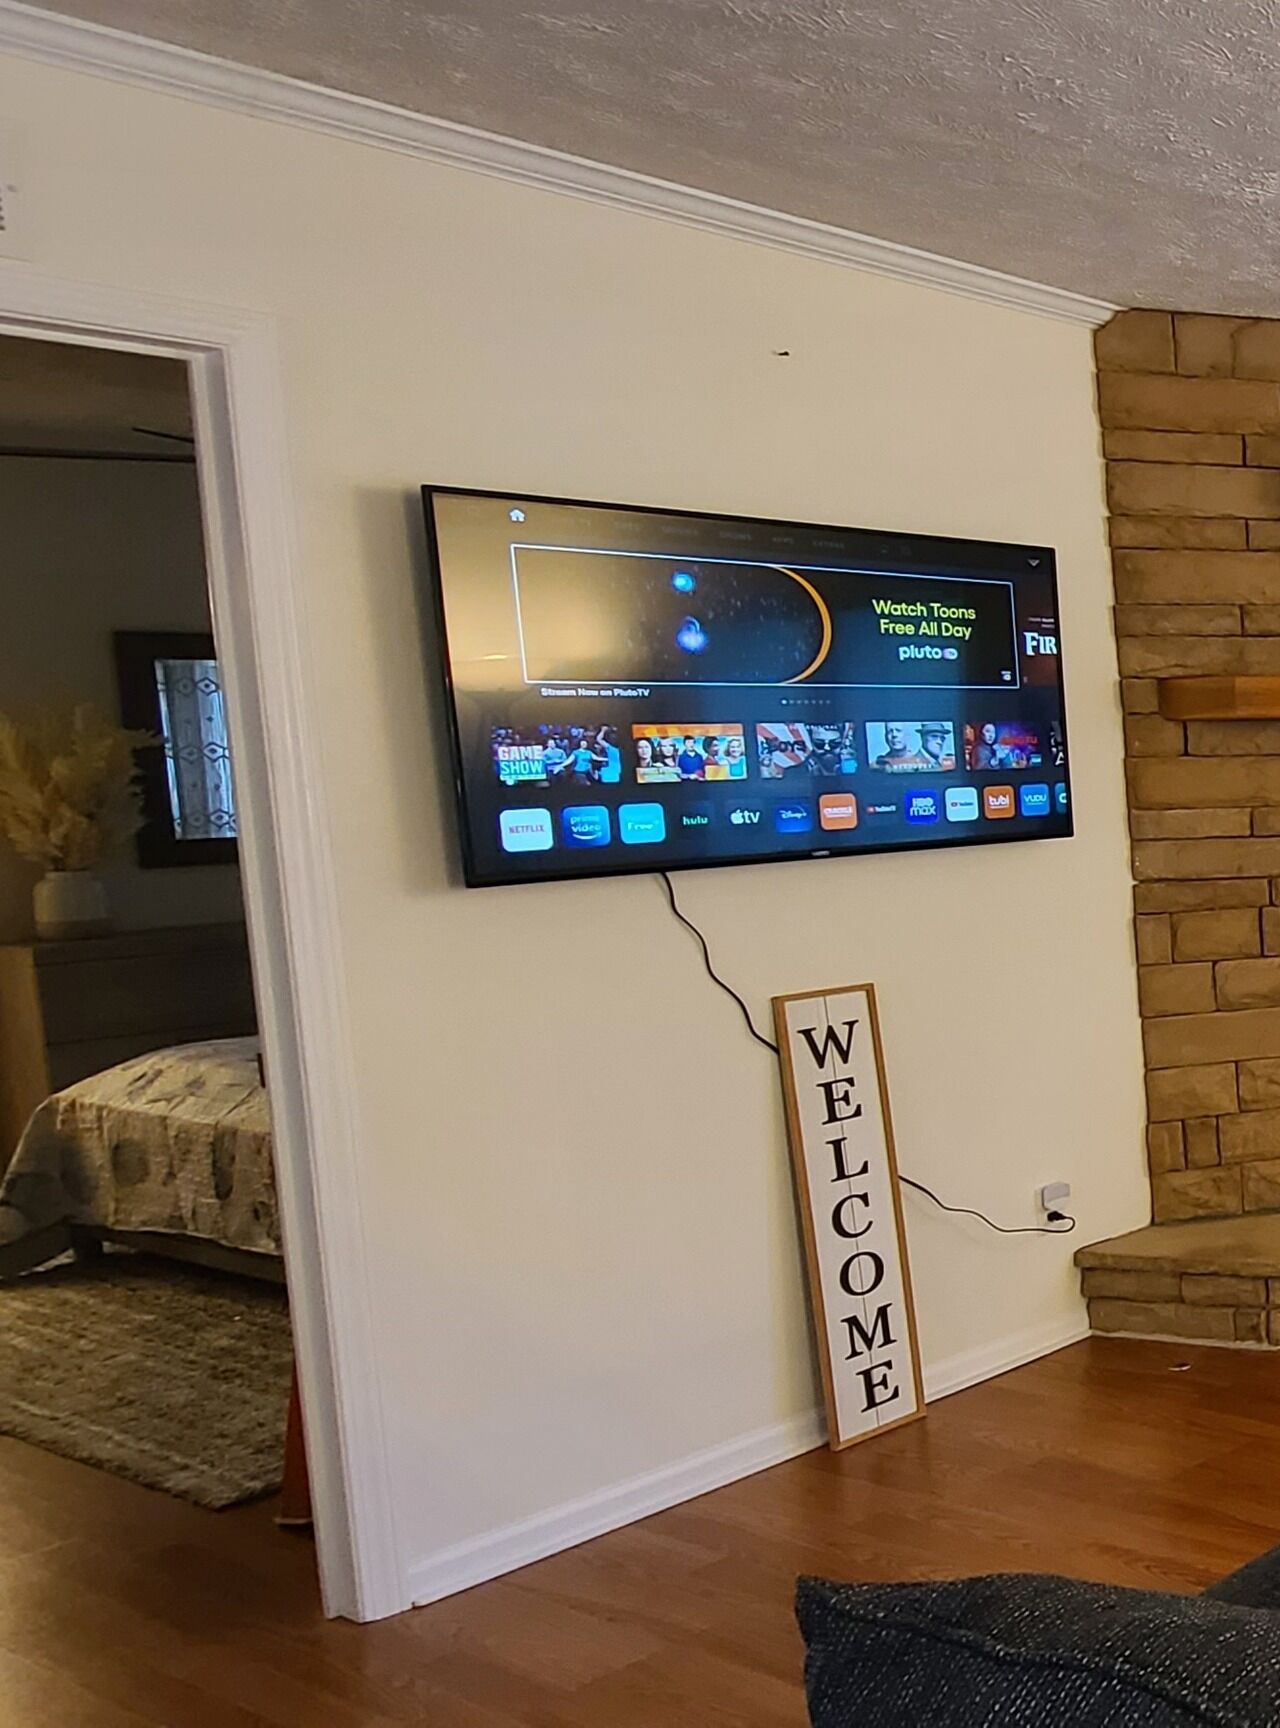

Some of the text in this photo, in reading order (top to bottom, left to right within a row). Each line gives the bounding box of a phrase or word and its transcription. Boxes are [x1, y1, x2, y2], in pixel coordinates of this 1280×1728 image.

[872, 599, 976, 619] Watch Toons
[879, 619, 972, 641] Free All Day
[898, 644, 942, 661] pluto
[498, 745, 544, 761] GAME
[500, 760, 543, 775] SHOW
[744, 810, 760, 824] tv
[909, 805, 936, 816] max
[682, 815, 708, 826] hulu
[508, 824, 545, 834] NETFLIX
[571, 824, 602, 833] video
[797, 1019, 900, 1414] WELCOME
